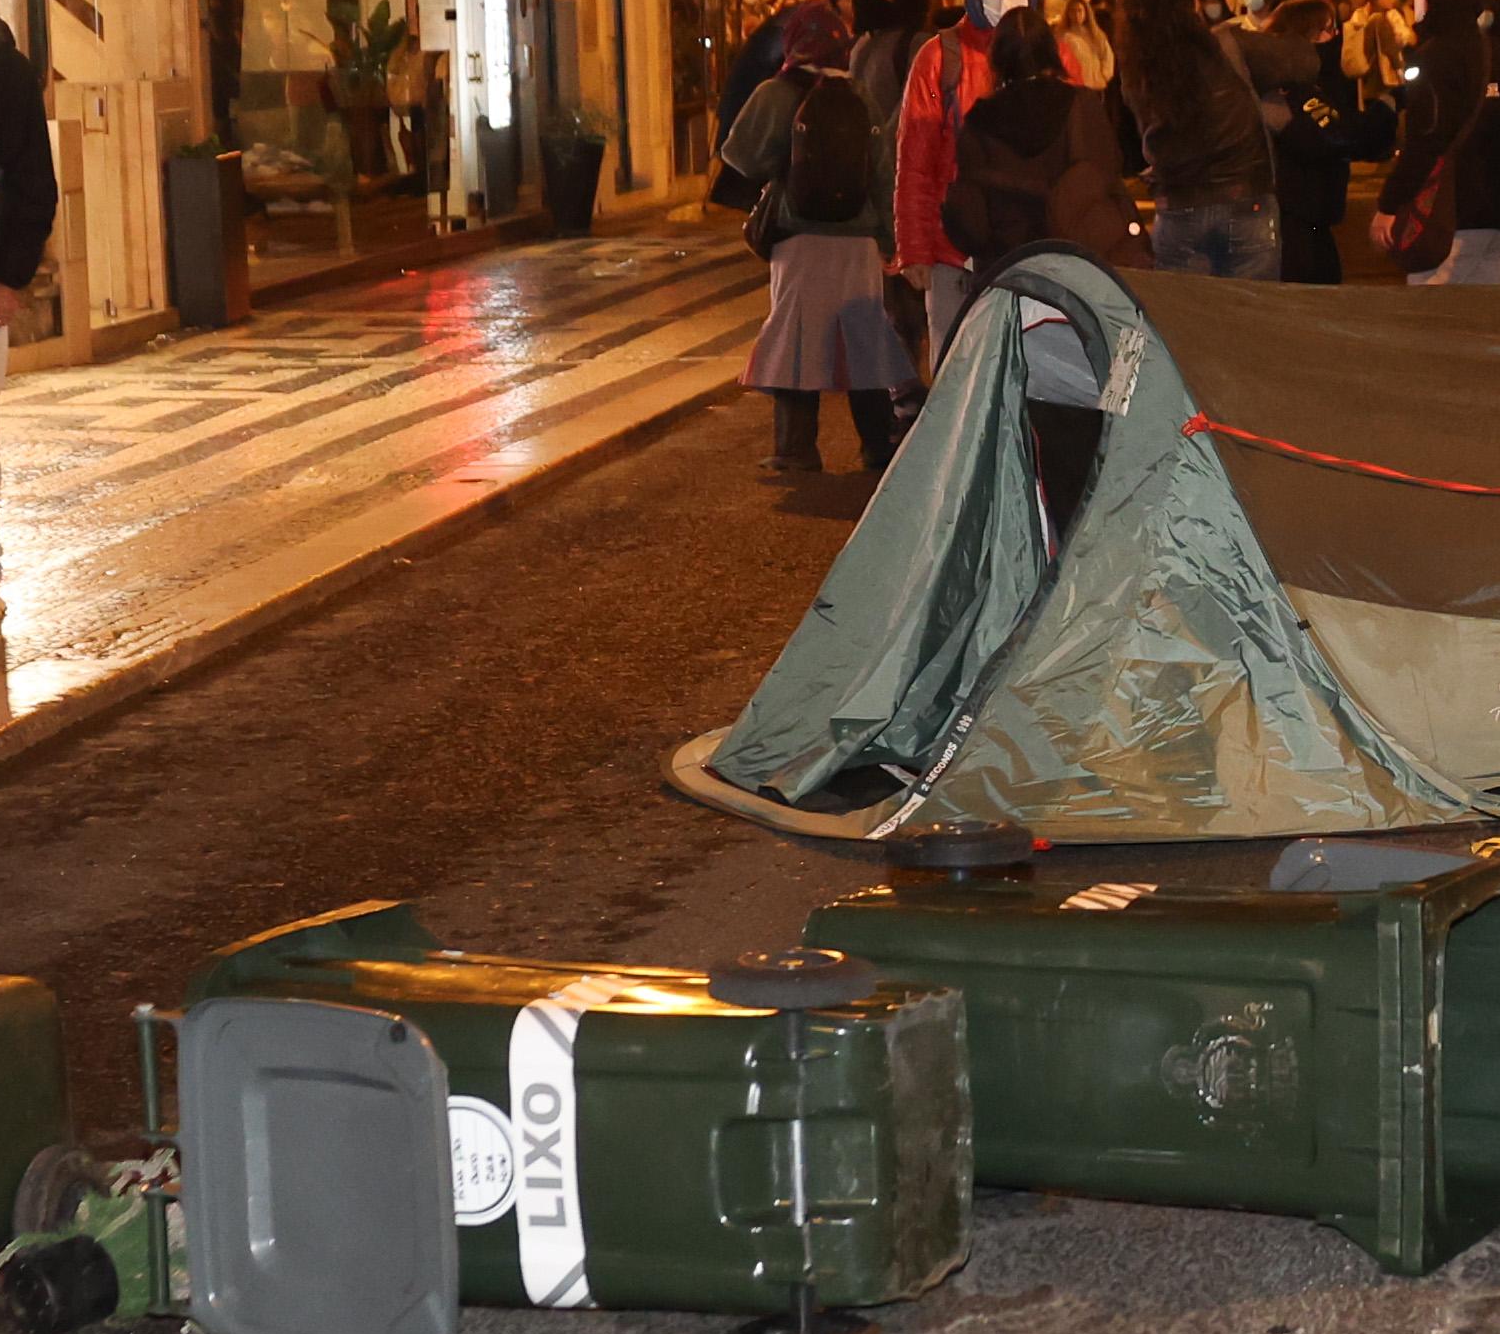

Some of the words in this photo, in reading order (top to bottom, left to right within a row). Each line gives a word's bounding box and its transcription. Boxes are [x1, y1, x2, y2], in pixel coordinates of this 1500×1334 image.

[925, 742, 958, 784] SECONDS
[921, 784, 930, 792] 2
[522, 1082, 567, 1228] LIXO
